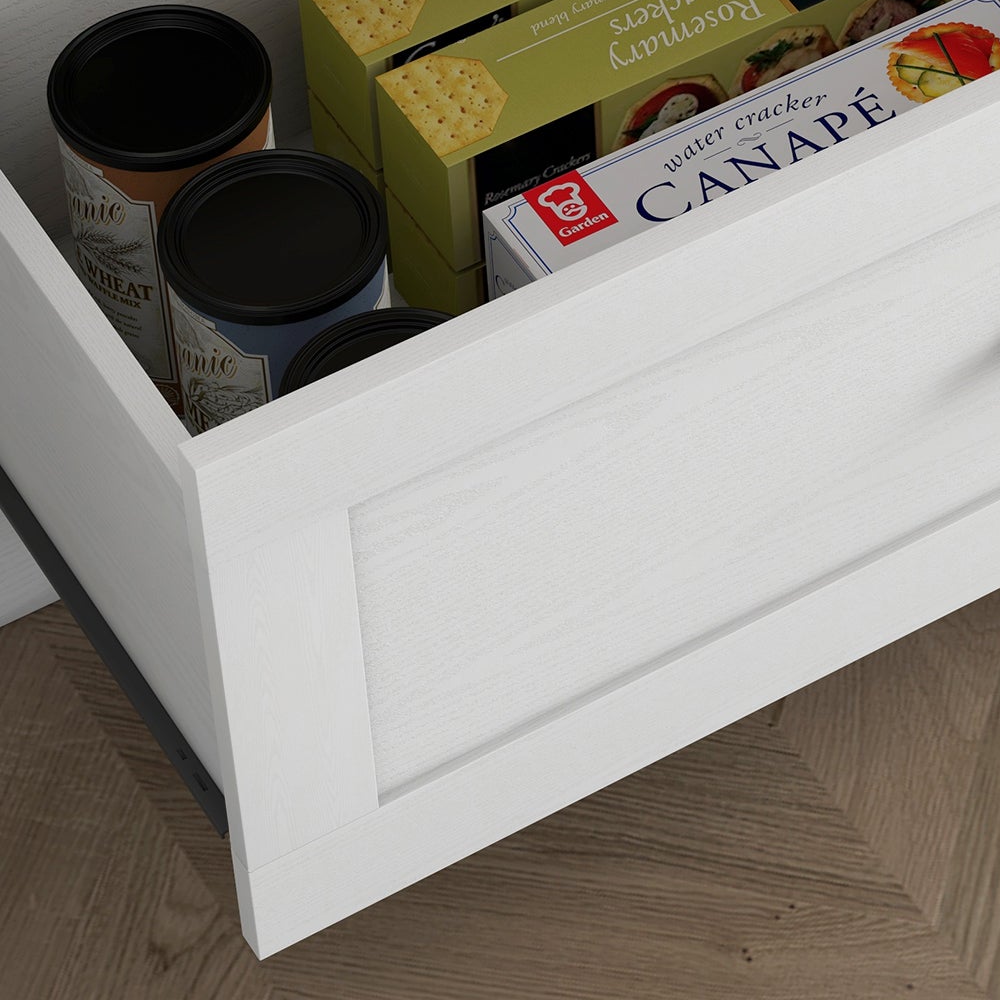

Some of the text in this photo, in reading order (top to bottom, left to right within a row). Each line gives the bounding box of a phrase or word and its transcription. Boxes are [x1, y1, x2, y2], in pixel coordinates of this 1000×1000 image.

[529, 10, 570, 37] blend
[663, 93, 828, 174] water cracker
[542, 152, 591, 179] Crackers
[636, 86, 897, 222] CANAPÉ
[558, 211, 610, 239] Garden
[84, 255, 153, 302] WHEAT
